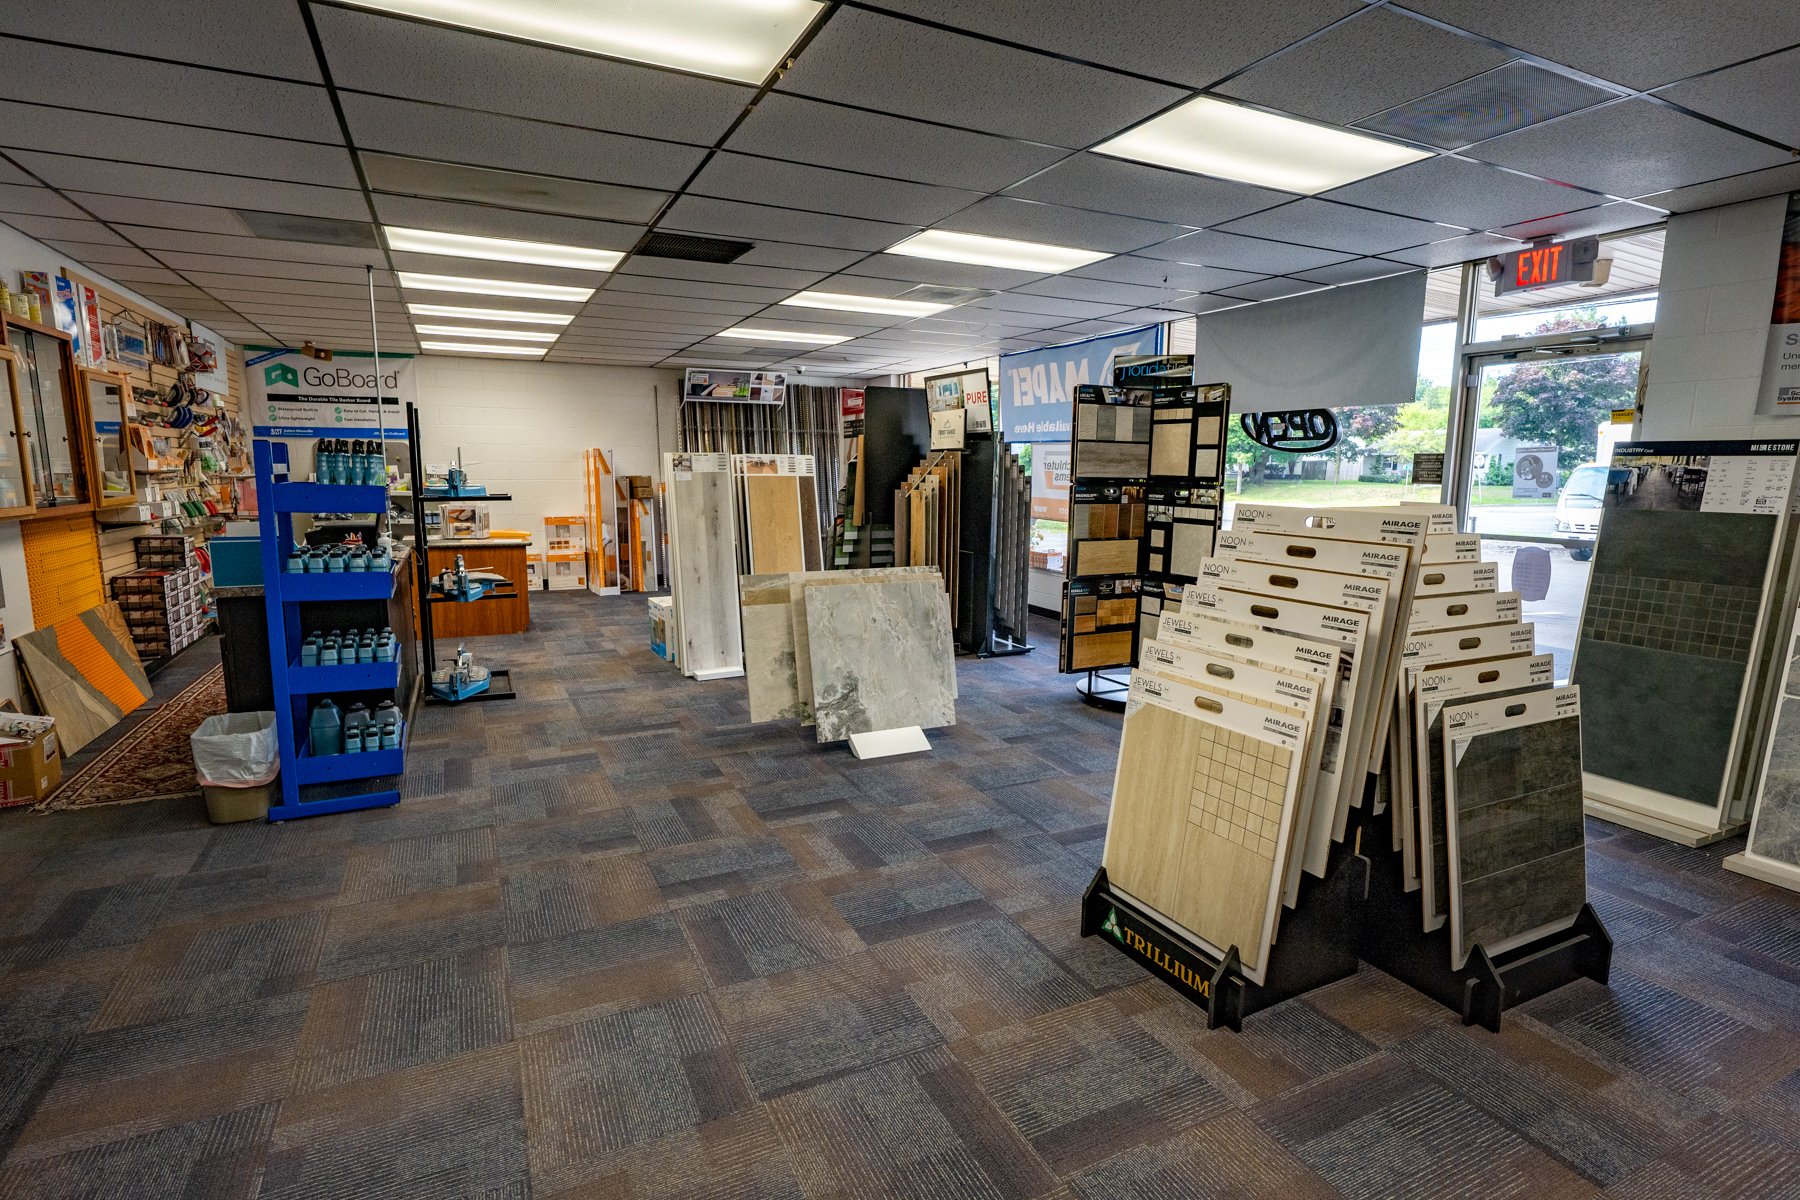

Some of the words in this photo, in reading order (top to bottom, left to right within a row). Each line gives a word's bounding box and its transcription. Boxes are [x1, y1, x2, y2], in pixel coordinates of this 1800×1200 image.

[1516, 246, 1563, 286] EXIT
[303, 366, 398, 389] GoBoard
[966, 391, 988, 404] PURE
[1238, 509, 1265, 518] NOON
[1382, 519, 1421, 529] MIRAGE
[1220, 536, 1247, 546] NOON
[1361, 551, 1401, 562] MIRAGE
[1203, 563, 1230, 574] NOON
[1343, 583, 1382, 595] MIRAGE
[1186, 590, 1217, 603] JEWELS
[1162, 616, 1193, 631] JEWELS
[1321, 614, 1360, 627] MIRAGE
[1509, 628, 1533, 637] MIRAGE
[1295, 645, 1333, 660] MIRAGE
[1402, 640, 1427, 652] NOON
[1144, 646, 1175, 661] JEWELS
[1529, 660, 1552, 669] MIRAGE
[1133, 676, 1163, 692] JEWELS
[1276, 679, 1313, 695] MIRAGE
[1421, 676, 1447, 687] NOON
[1555, 692, 1578, 702] MIRAGE
[1449, 710, 1474, 723] NOON
[1263, 716, 1301, 733] MIRAGE
[1124, 926, 1210, 999] TRILLIUM
